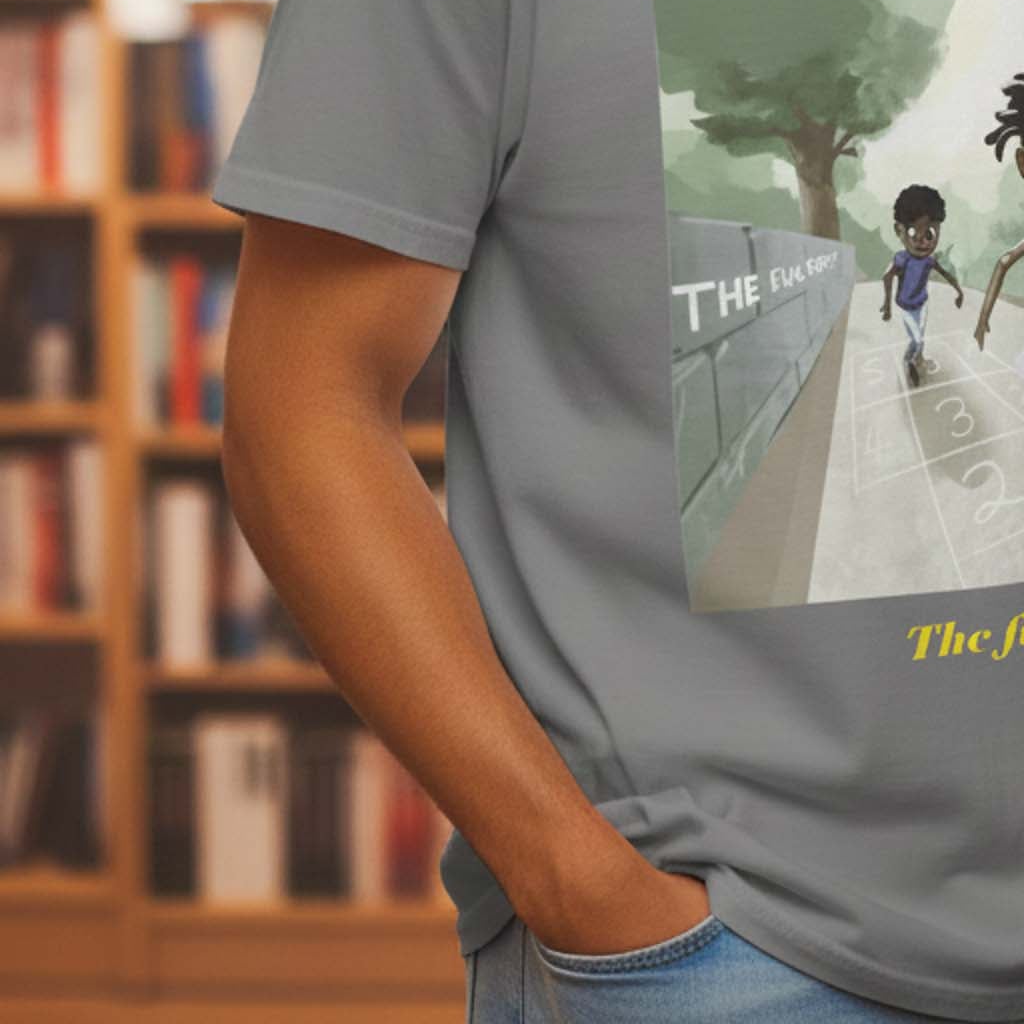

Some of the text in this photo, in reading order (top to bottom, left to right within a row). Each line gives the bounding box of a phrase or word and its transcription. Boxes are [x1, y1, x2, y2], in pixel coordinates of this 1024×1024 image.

[671, 274, 760, 332] THE
[934, 396, 975, 438] 3
[906, 621, 992, 661] The
